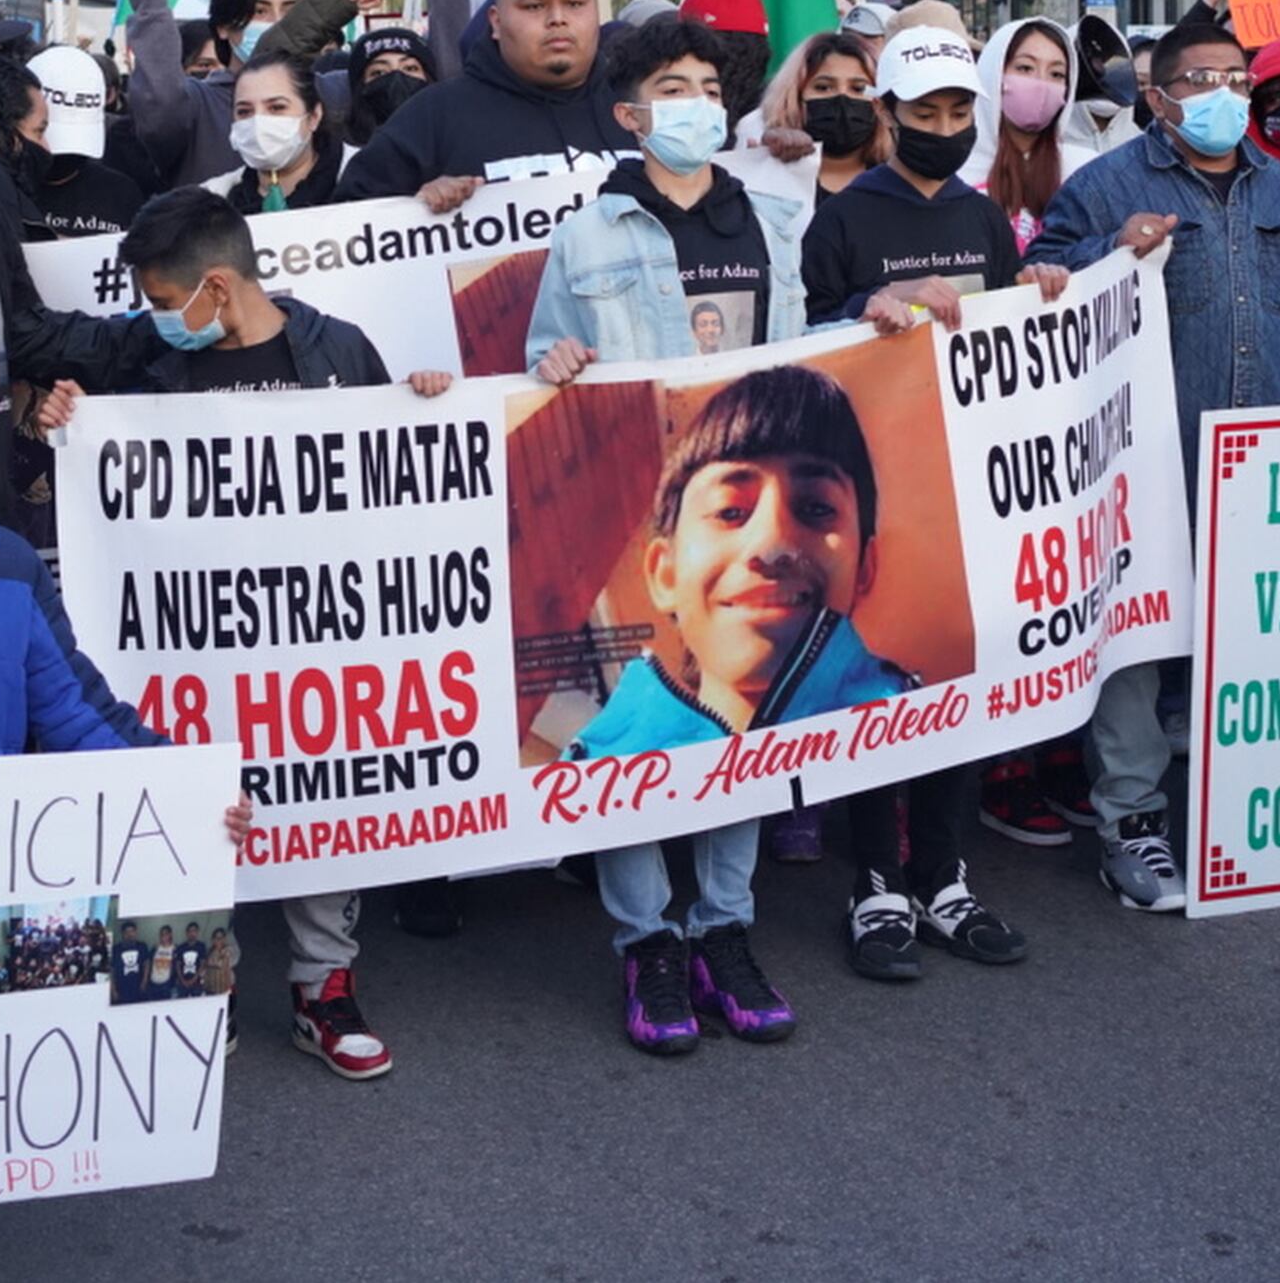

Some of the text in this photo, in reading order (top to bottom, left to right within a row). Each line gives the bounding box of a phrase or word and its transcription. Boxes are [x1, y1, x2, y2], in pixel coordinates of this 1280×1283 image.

[73, 215, 122, 233] Adam
[882, 251, 986, 274] Justice for Adam
[698, 262, 759, 278] for Adam
[950, 323, 1019, 407] CPD
[1024, 301, 1092, 390] STOP
[98, 420, 493, 521] CPD DEJA DE MATAR
[986, 434, 1061, 519] OUR
[119, 546, 492, 651] A NUESTRAS HIJOS
[1014, 525, 1069, 613] 48
[137, 673, 211, 745] 48
[234, 649, 480, 759] HORAS
[241, 740, 481, 807] RIMIENTO
[533, 683, 969, 824] R.I.P. Adam Toledo
[235, 792, 508, 867] CIAPARAADAM
